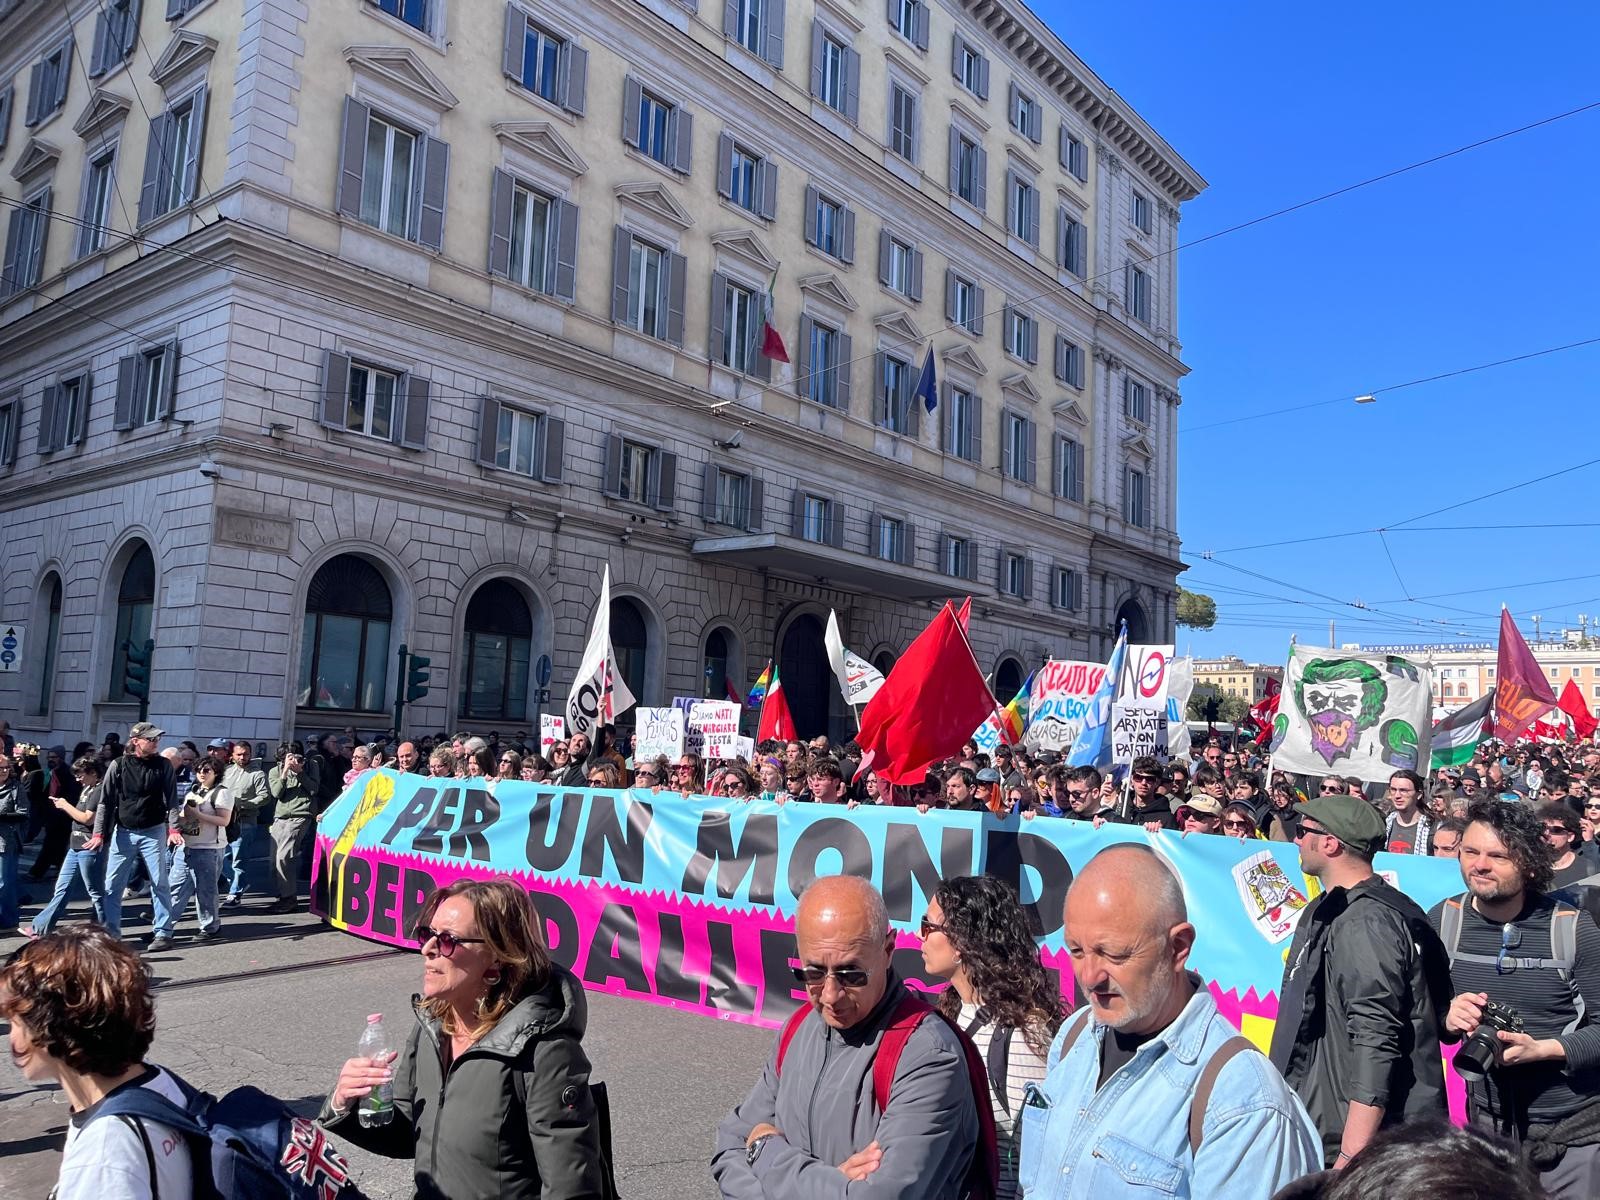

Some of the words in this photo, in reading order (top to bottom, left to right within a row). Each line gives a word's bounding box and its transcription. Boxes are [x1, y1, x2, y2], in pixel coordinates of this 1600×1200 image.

[249, 519, 266, 531] VIA
[1119, 645, 1165, 700] NO
[715, 709, 733, 720] NATI
[1066, 698, 1092, 720] GOV
[708, 735, 732, 745] TESTA
[709, 745, 721, 757] RE
[380, 787, 501, 862] PER
[525, 793, 653, 884] UN
[682, 807, 1185, 943] MOND
[310, 847, 441, 942] LIBER
